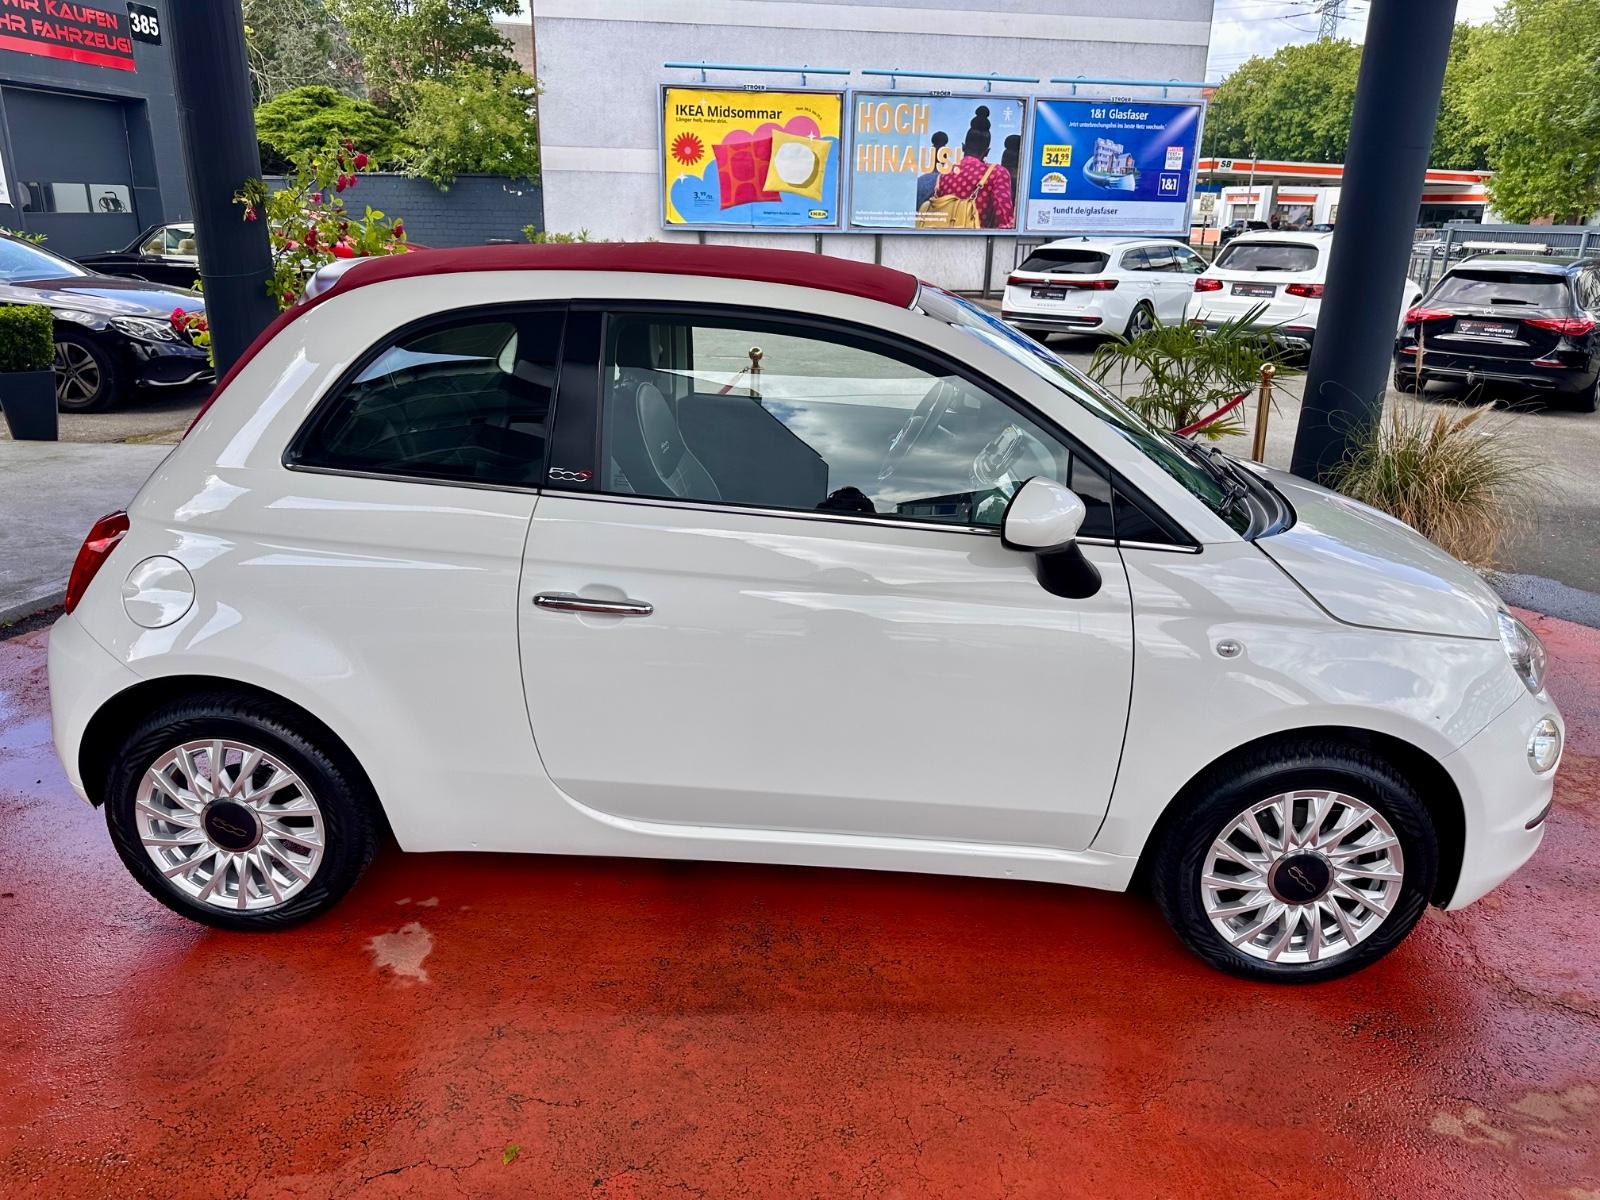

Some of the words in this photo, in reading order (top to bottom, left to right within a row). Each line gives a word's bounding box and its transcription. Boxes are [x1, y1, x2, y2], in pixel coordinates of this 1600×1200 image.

[44, 0, 119, 30] KAUFEN
[130, 12, 159, 37] 385
[675, 104, 704, 116] IKEA
[707, 105, 783, 119] Midsommar
[857, 101, 929, 135] HOCH
[1090, 108, 1106, 119] 1&1
[1108, 108, 1149, 121] Glasfaser
[856, 144, 962, 175] HINAUS!
[1045, 153, 1070, 165] 34,99
[1220, 160, 1232, 168] SB
[1161, 178, 1177, 190] 1&1
[1052, 206, 1119, 216] 1und1.de/glasfaser
